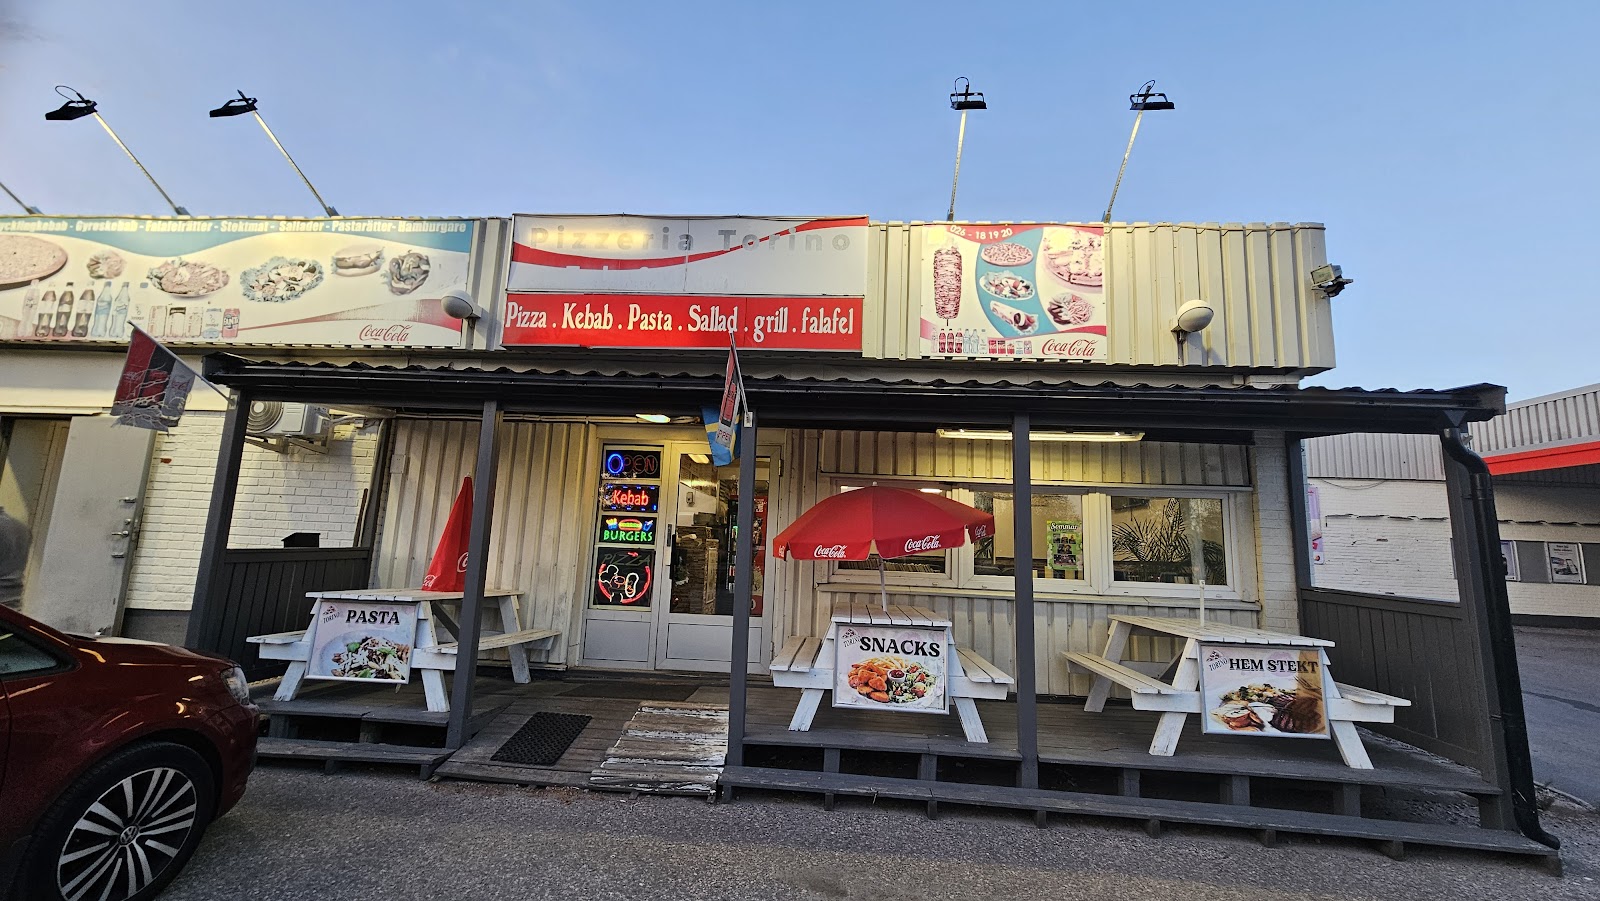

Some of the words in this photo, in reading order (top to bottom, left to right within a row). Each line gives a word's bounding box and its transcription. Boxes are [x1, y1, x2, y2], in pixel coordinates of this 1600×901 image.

[397, 220, 467, 234] Hamburgare
[950, 225, 966, 236] 026
[975, 231, 987, 240] 18
[988, 231, 999, 239] 19
[1000, 227, 1013, 238] 20
[531, 225, 694, 251] Pizzeria
[718, 227, 851, 251] Torino
[505, 301, 547, 328] Pizza
[561, 302, 614, 330] Kebab
[627, 303, 673, 331] Pasta
[687, 304, 738, 333] Sallad
[753, 306, 788, 343] grill
[801, 307, 854, 335] falafel
[608, 453, 659, 475] OPEN
[612, 489, 649, 506] Kebab
[603, 530, 653, 542] BURGERS
[601, 552, 651, 566] PIZZA
[345, 609, 400, 625] PASTA
[860, 636, 940, 657] SNACKS
[1229, 658, 1265, 671] HEM
[1267, 659, 1318, 674] STEKT
